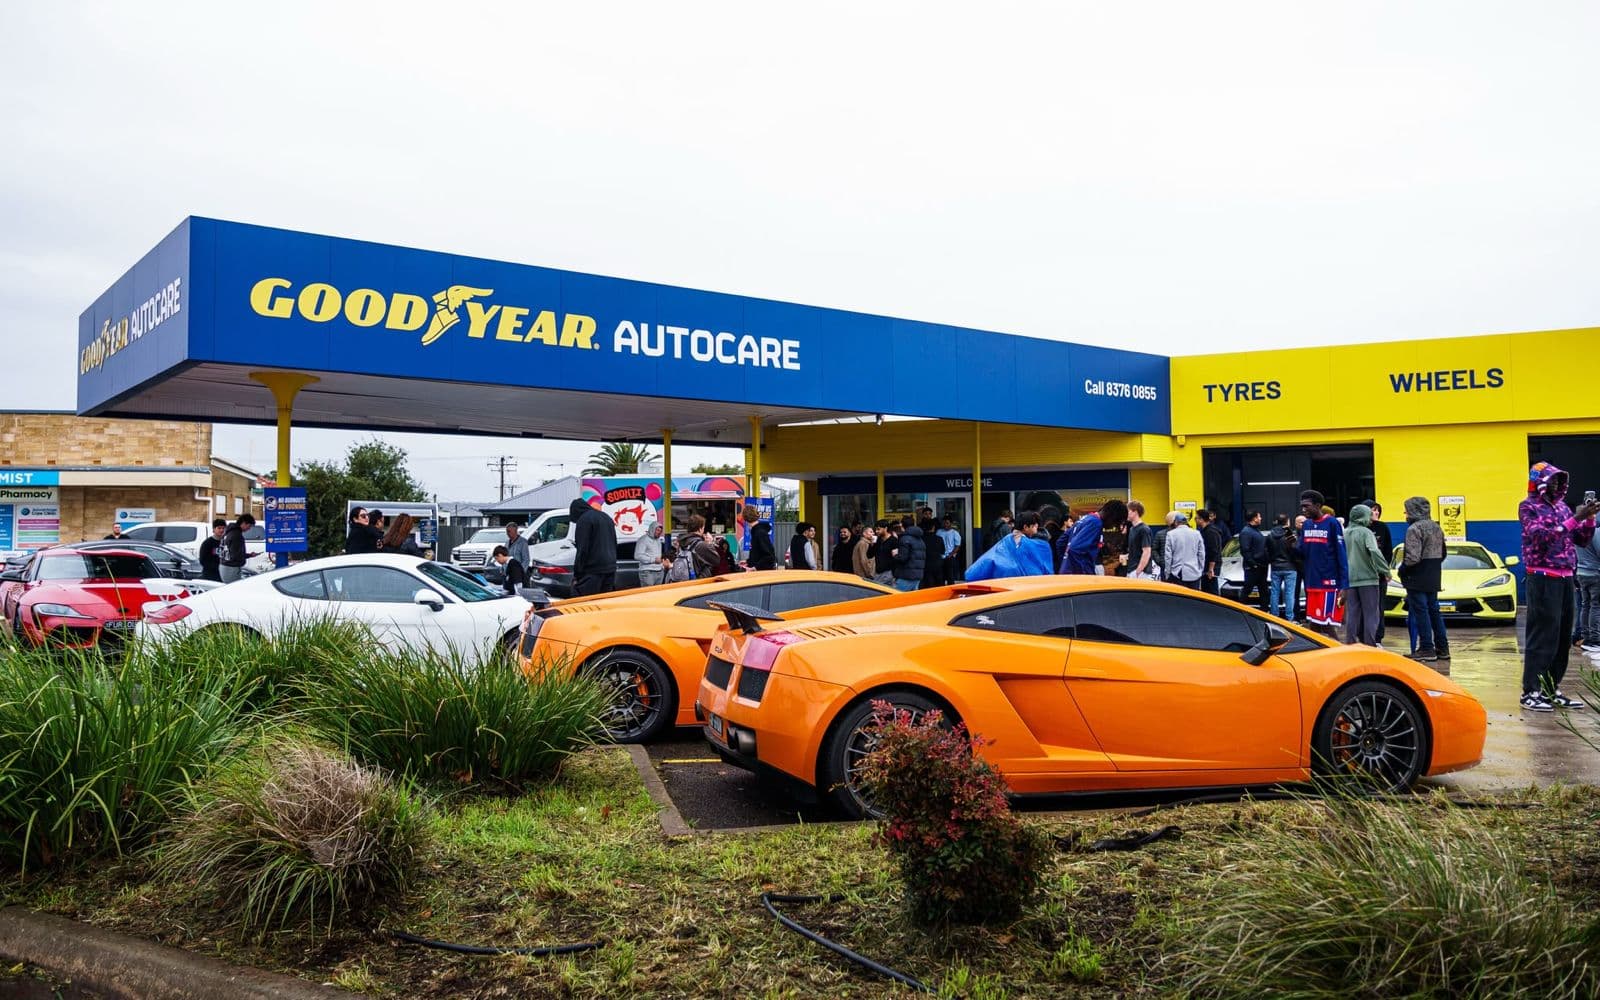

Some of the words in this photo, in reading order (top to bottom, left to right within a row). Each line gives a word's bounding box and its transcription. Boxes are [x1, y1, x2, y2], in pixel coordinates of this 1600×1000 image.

[131, 277, 182, 342] AUTOCARE
[249, 277, 597, 349] GOODYEAR
[613, 319, 801, 371] AUTOCARE
[1084, 379, 1105, 395] Call
[1106, 381, 1131, 398] 8376
[1132, 384, 1157, 401] 0855
[1389, 367, 1504, 393] WHEELS
[1203, 380, 1281, 403] TYRES
[0, 472, 34, 484] MIST
[945, 478, 993, 488] WELCME
[0, 490, 53, 500] Pharmacy
